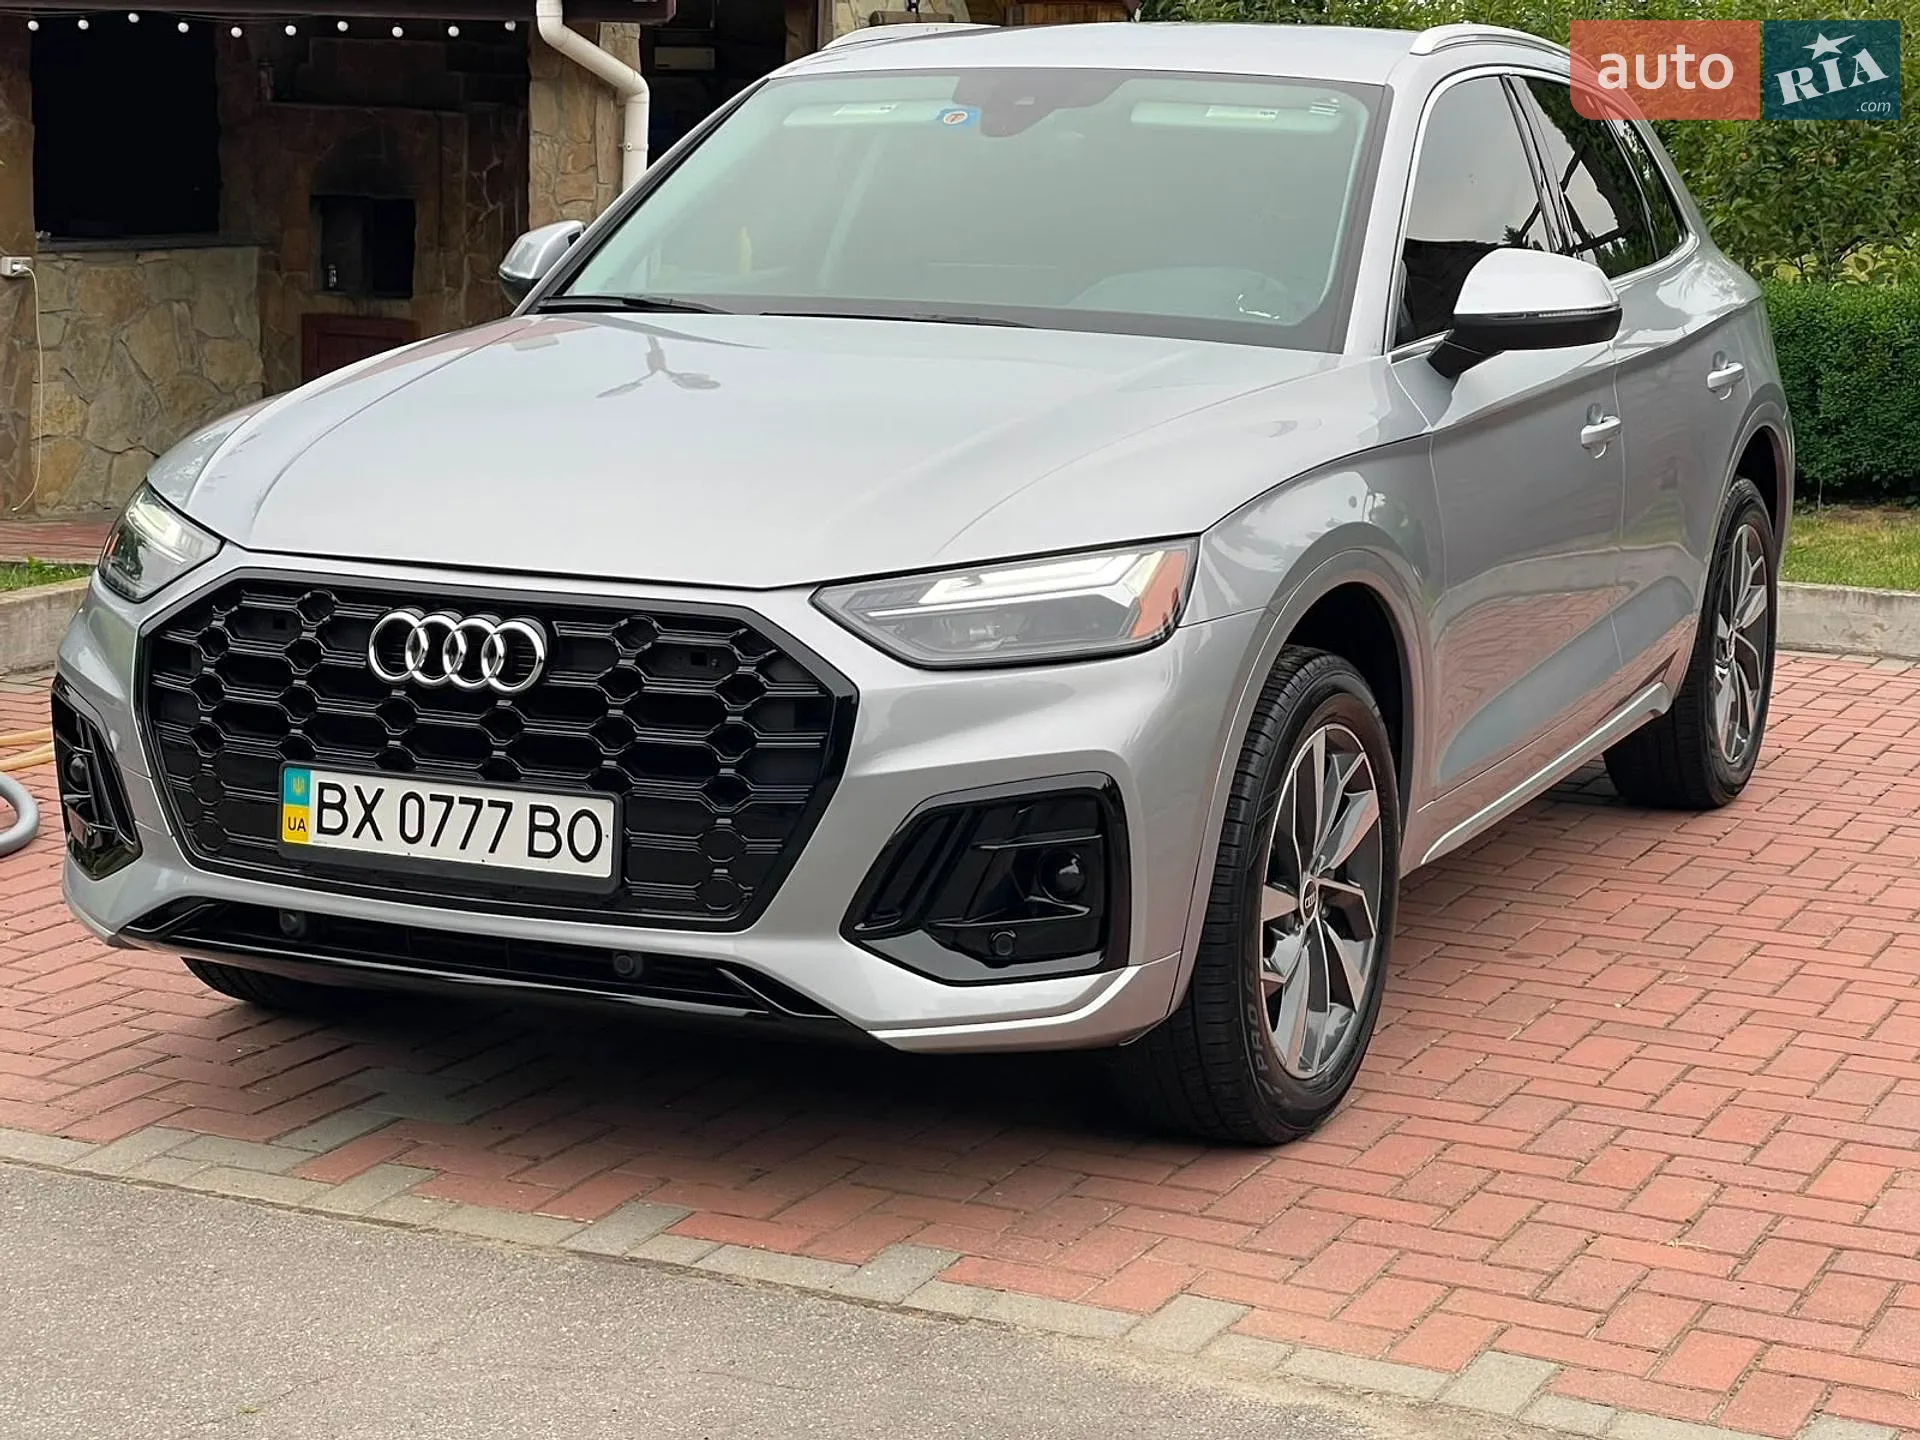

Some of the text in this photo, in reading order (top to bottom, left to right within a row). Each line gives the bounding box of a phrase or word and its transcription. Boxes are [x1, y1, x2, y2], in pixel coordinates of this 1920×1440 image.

[287, 816, 307, 833] UA
[316, 781, 604, 864] BX 0777 BO
